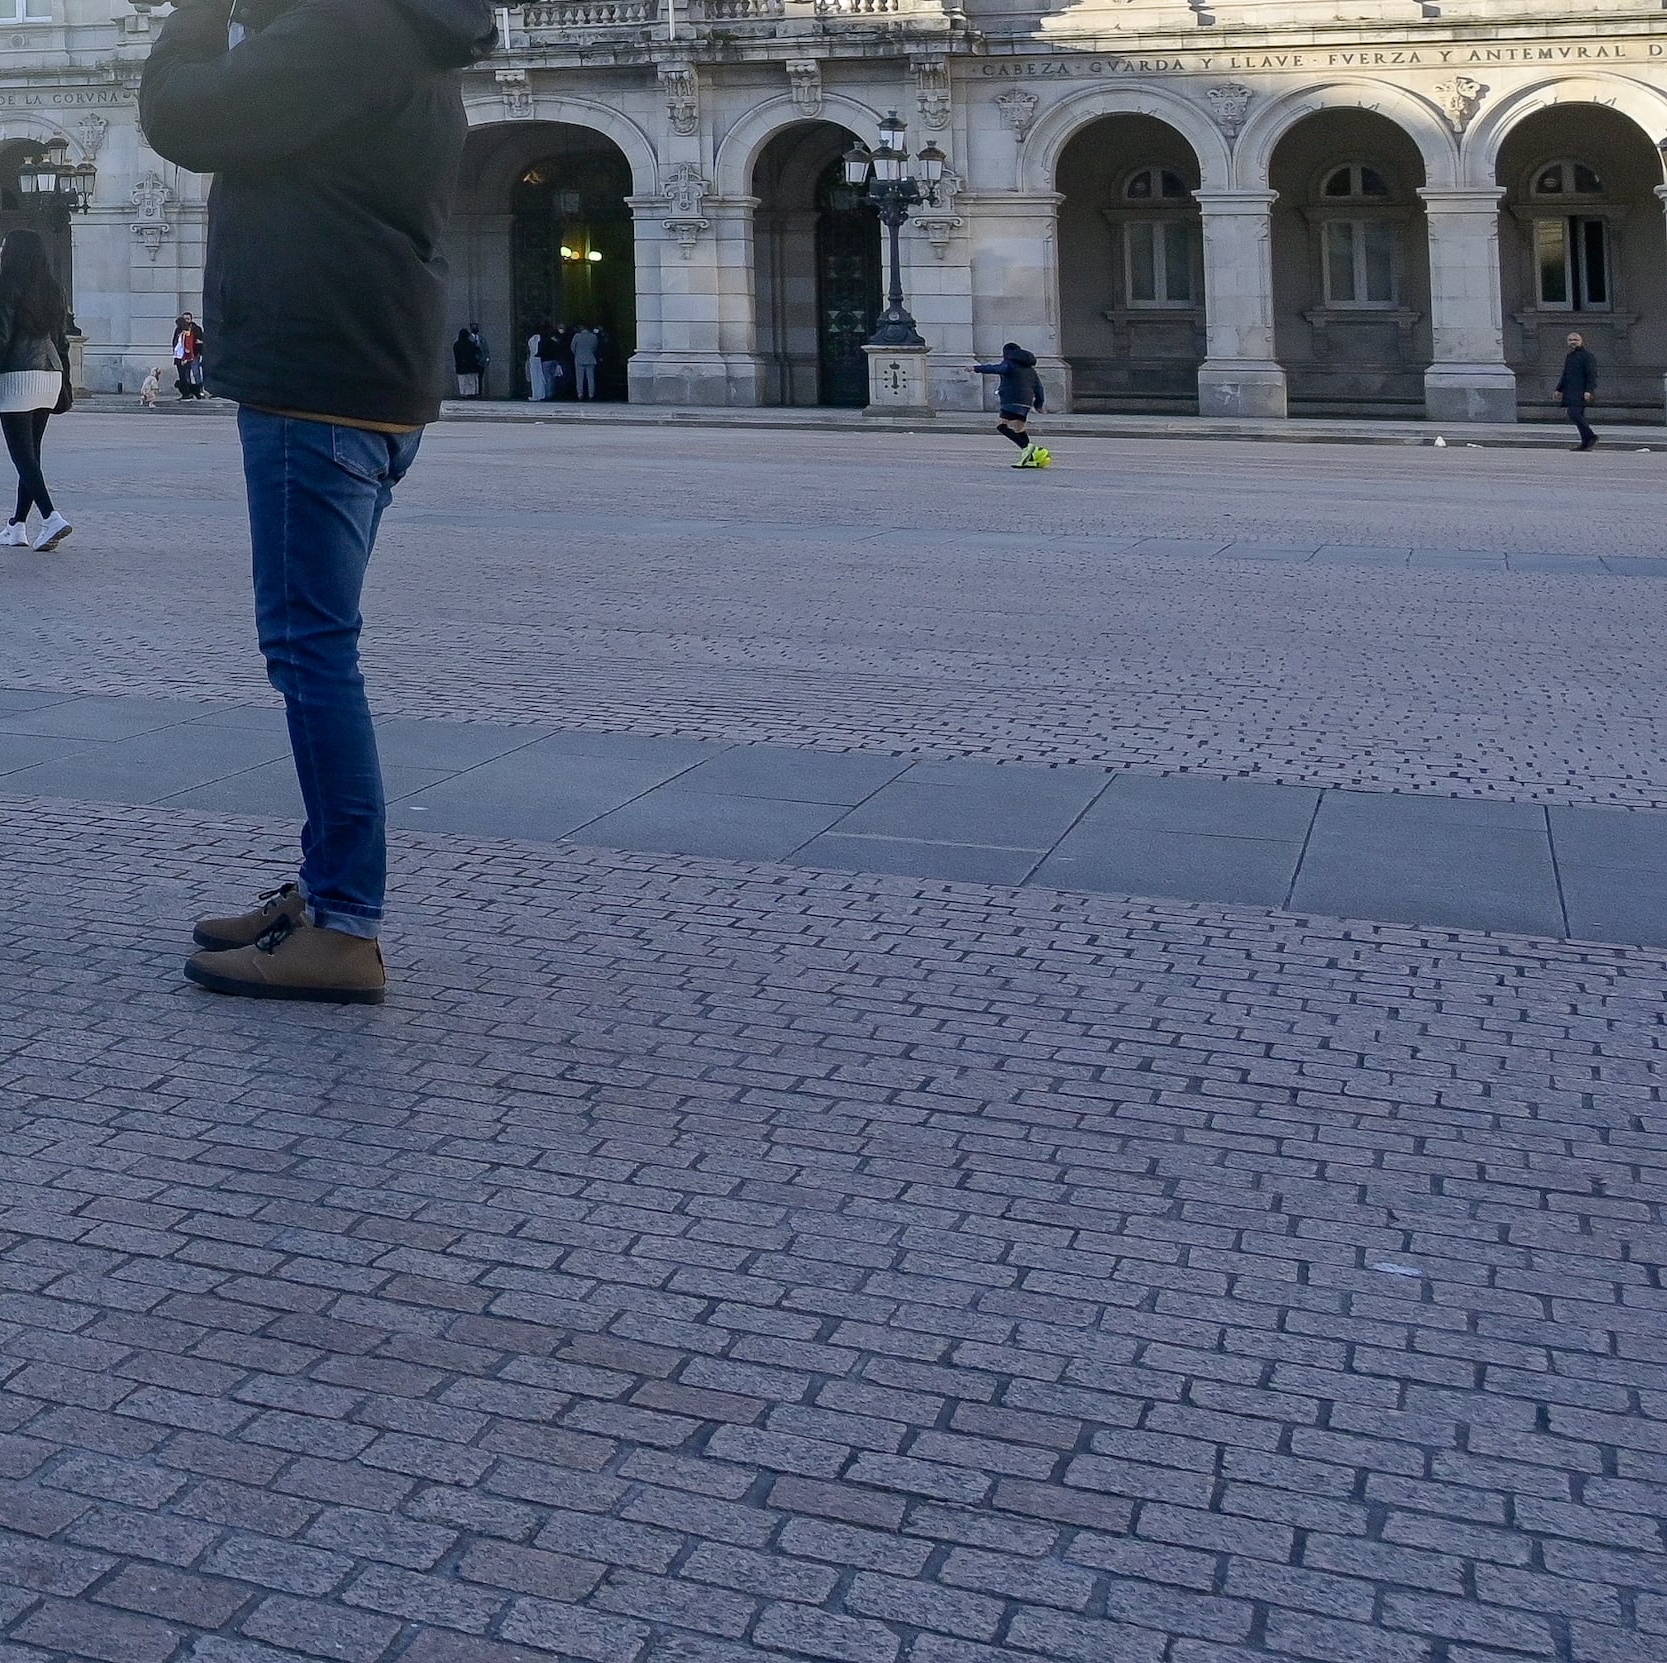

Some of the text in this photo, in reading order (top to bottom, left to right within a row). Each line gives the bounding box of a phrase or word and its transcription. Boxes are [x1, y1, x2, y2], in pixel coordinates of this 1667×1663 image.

[982, 62, 1069, 77] CABEZA
[1201, 58, 1213, 70] Y
[1231, 55, 1304, 70] LLAVE
[1328, 52, 1422, 66] FVERZA
[1438, 50, 1453, 63] Y
[1469, 45, 1627, 63] ANTEMVRAL
[25, 93, 43, 105] LA
